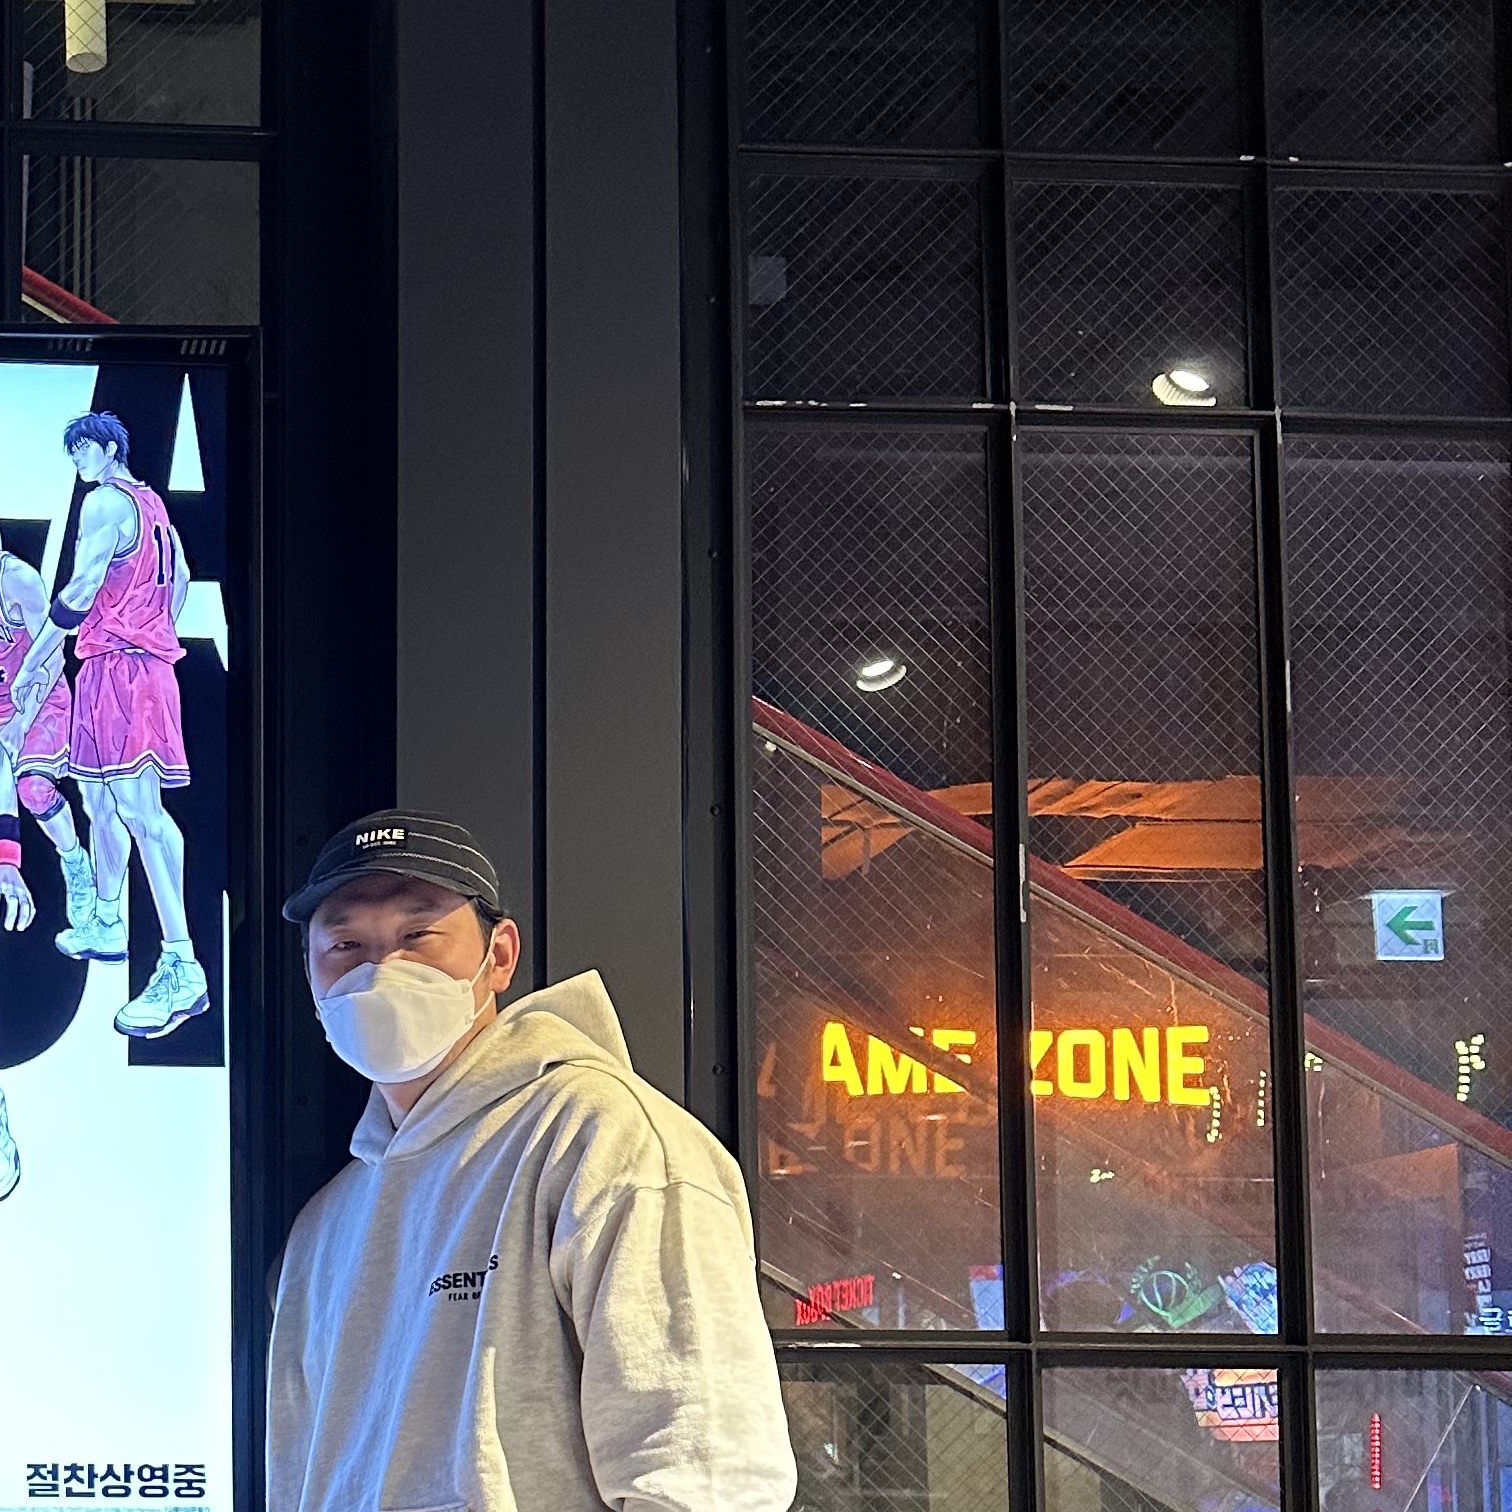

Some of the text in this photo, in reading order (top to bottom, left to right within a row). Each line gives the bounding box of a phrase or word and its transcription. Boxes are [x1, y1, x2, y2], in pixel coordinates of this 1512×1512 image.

[356, 829, 405, 845] NIKE
[822, 1021, 976, 1097] AME
[26, 1463, 207, 1498] 절찬상영중
